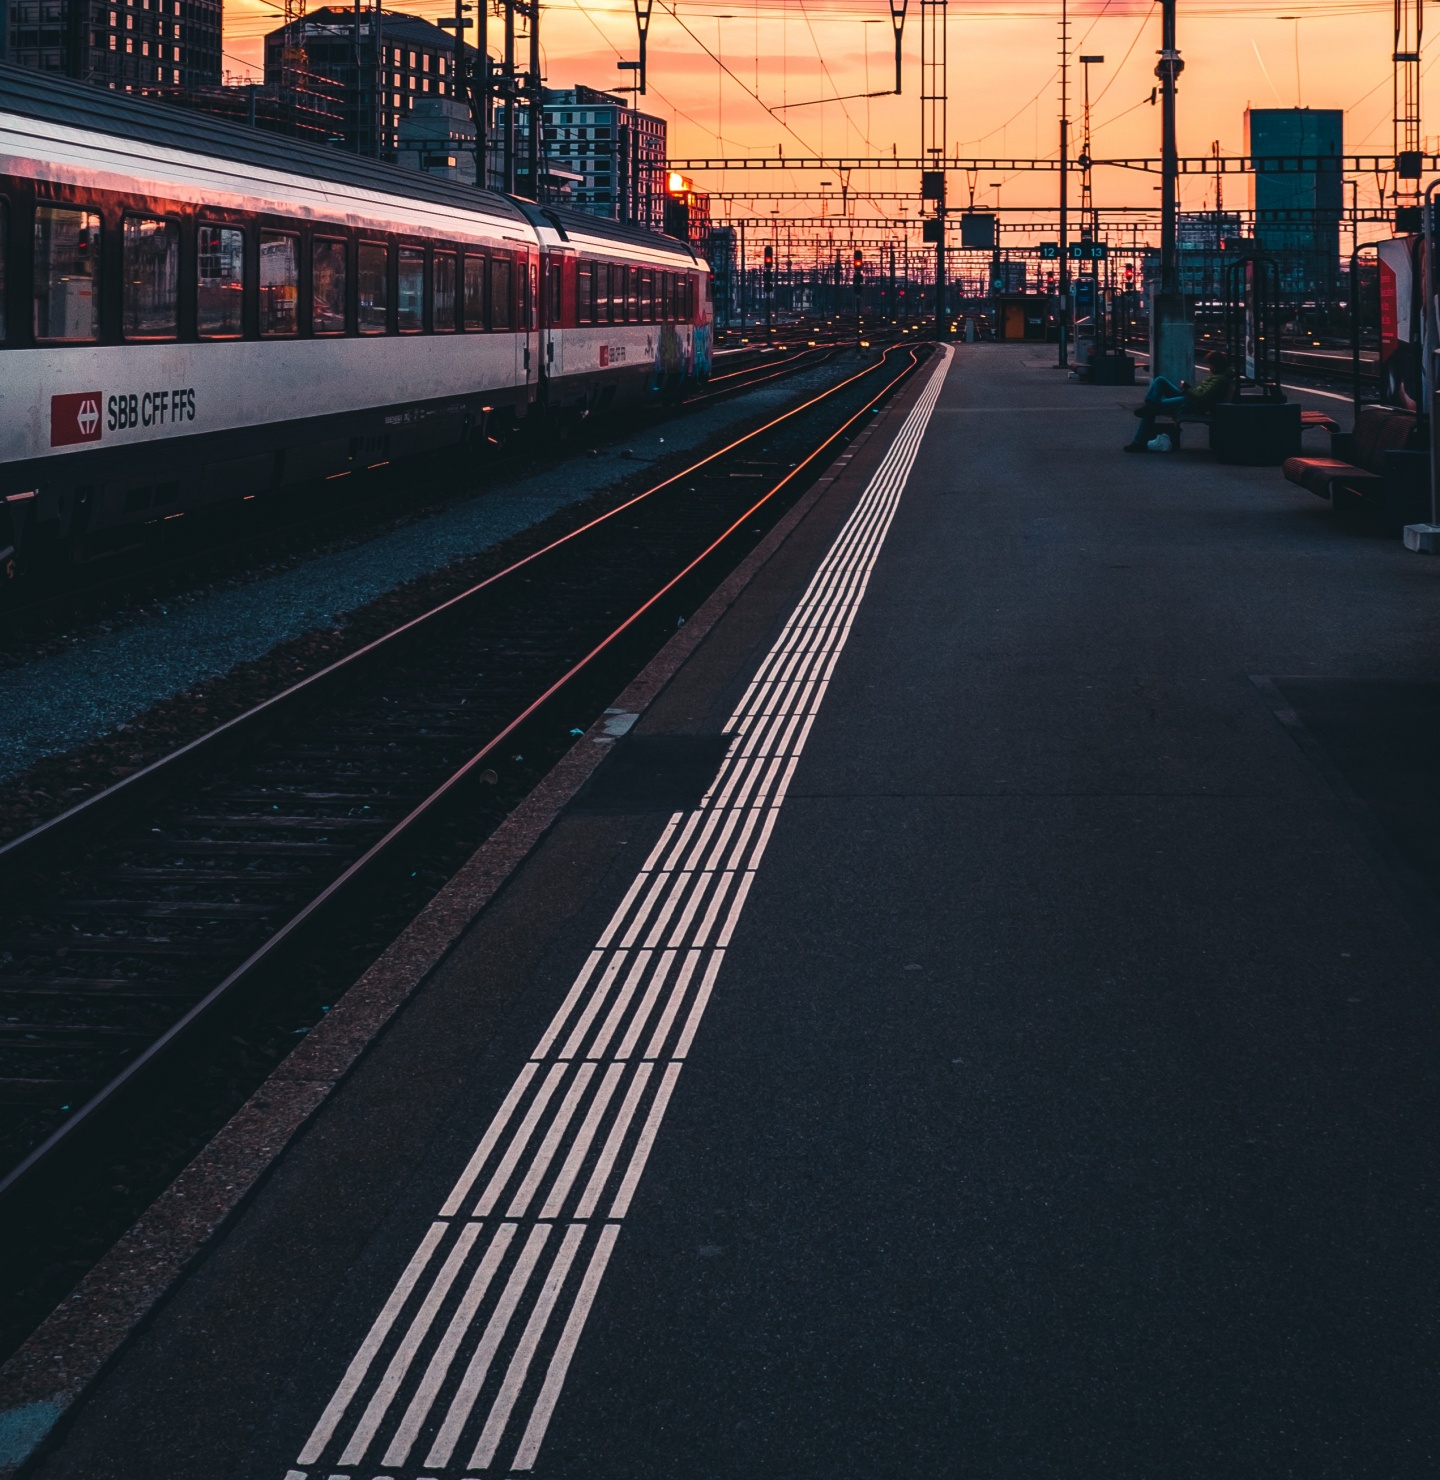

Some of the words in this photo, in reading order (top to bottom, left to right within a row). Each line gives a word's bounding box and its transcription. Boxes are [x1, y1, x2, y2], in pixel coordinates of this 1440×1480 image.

[1043, 247, 1055, 257] 12
[1074, 247, 1082, 257] D
[1091, 247, 1102, 257] 13
[545, 257, 550, 276] 2
[107, 394, 138, 431] SBB
[141, 391, 169, 427] CFF
[171, 388, 196, 423] FFS
